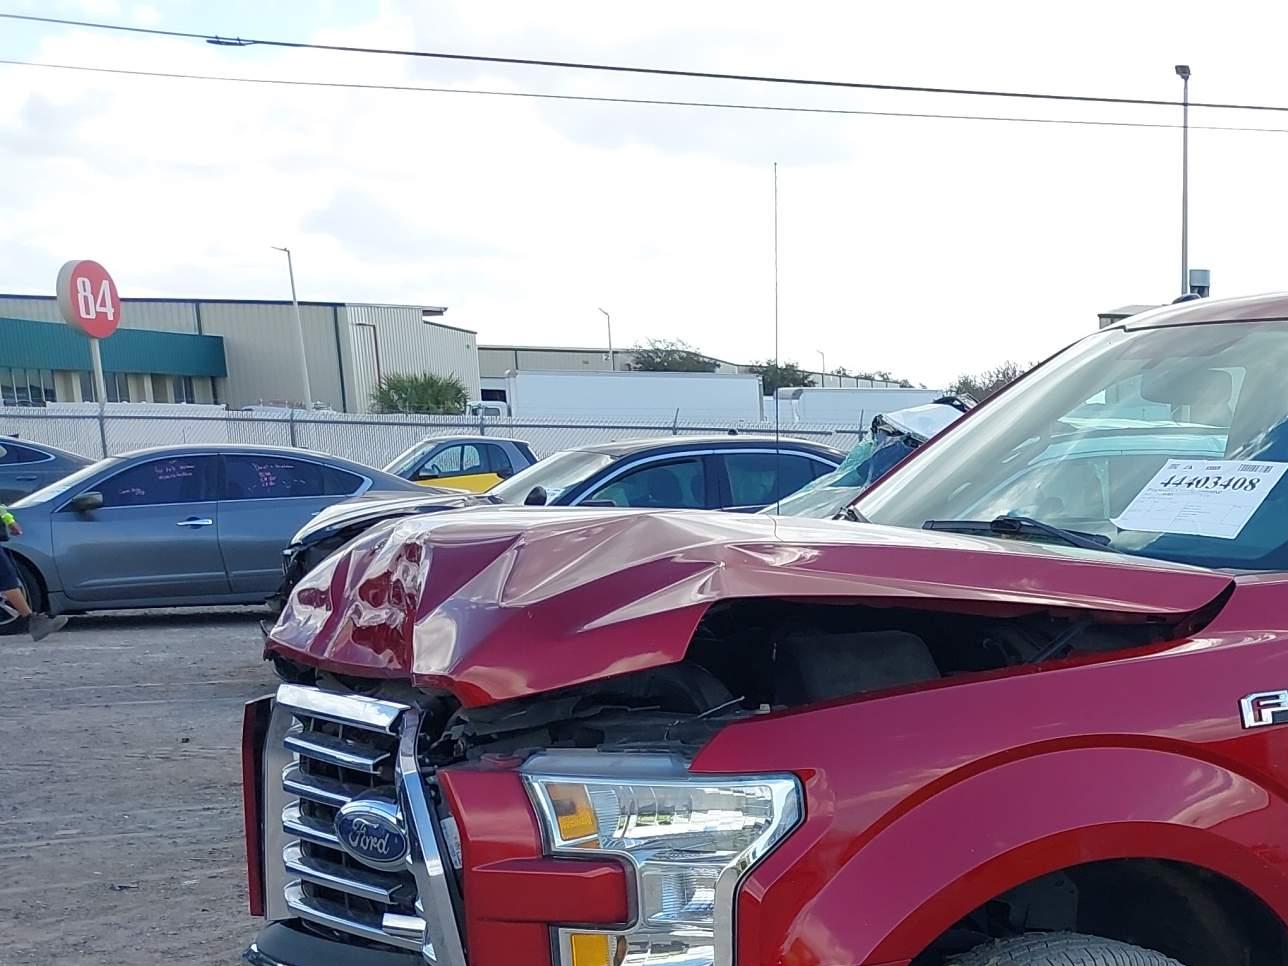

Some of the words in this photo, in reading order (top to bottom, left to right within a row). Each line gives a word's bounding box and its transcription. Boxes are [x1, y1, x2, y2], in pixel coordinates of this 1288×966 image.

[76, 277, 115, 321] 84
[1160, 474, 1261, 492] 44403408
[348, 817, 391, 855] Ford
